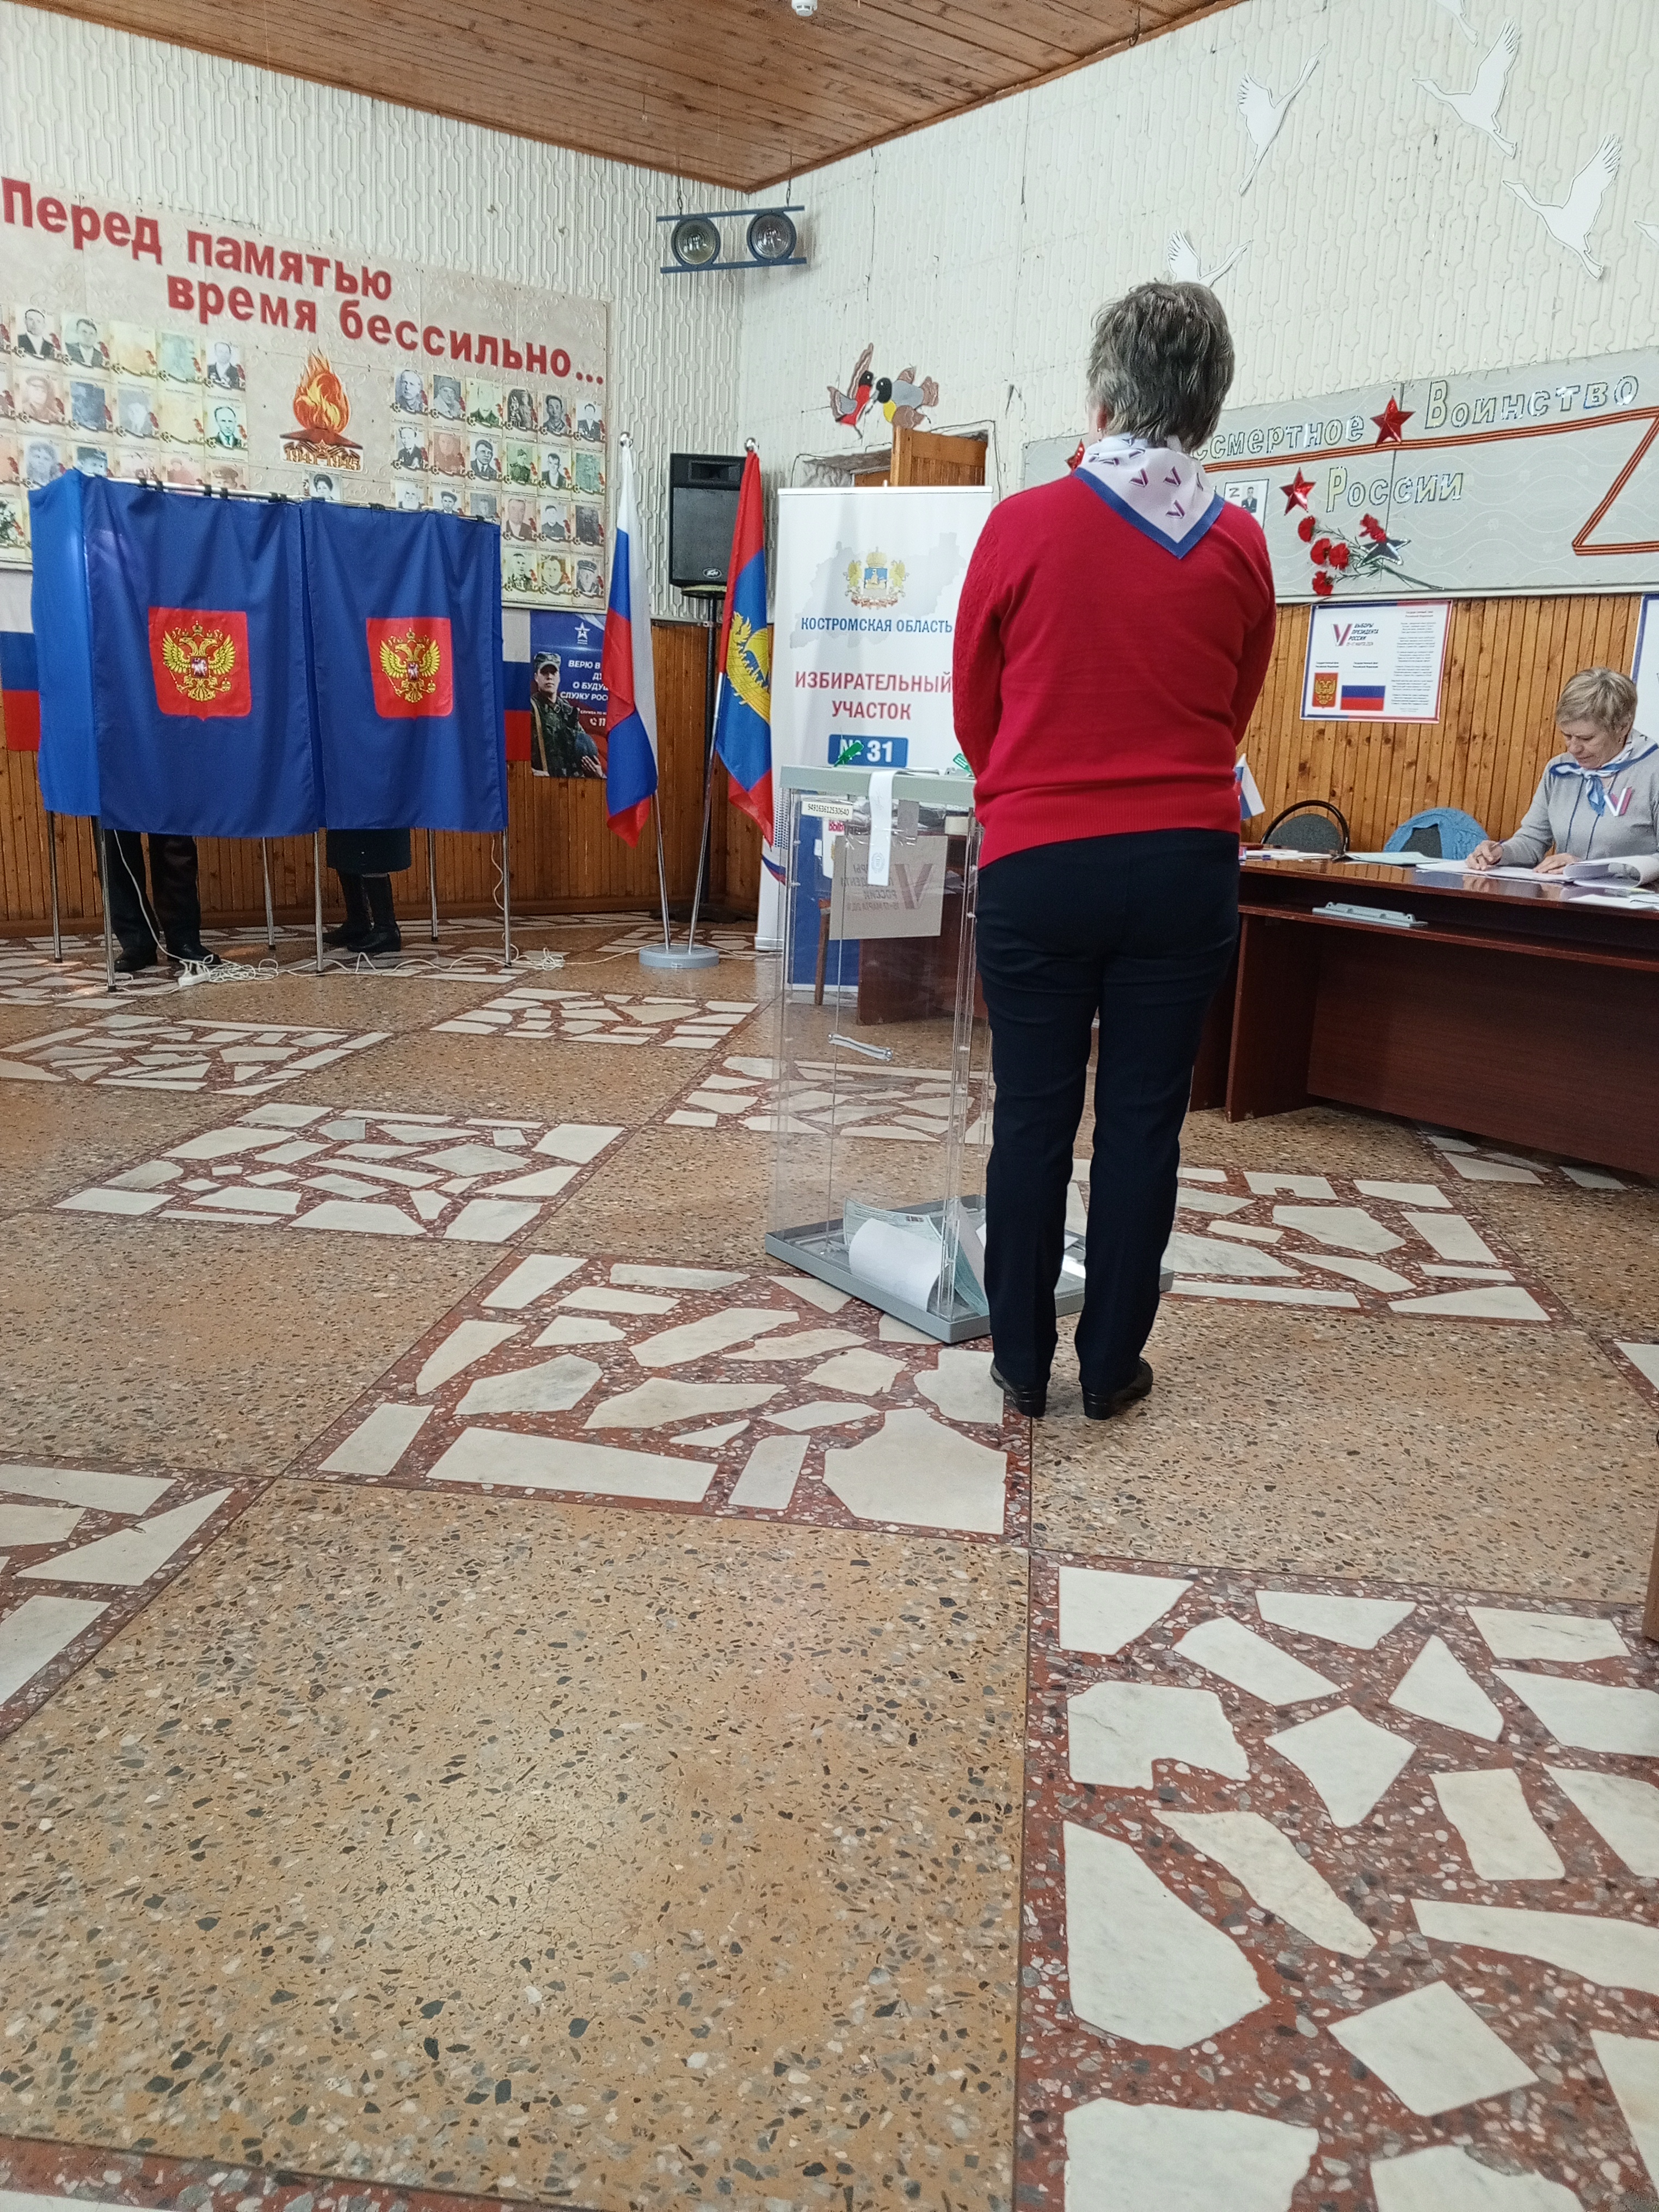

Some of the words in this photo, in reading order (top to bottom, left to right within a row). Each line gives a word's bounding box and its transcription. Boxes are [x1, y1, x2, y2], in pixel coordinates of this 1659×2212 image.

[2, 176, 163, 265] Перед
[187, 229, 391, 300] памятью
[167, 274, 317, 333] время
[339, 299, 604, 385] бессильно...
[1424, 375, 1639, 429] Воинство
[1326, 466, 1464, 513] России
[801, 618, 892, 632] КОСТРОМСКАЯ
[896, 620, 952, 633] ОБЛАСТЬ
[568, 660, 593, 668] ВЕРЮ
[795, 672, 951, 693] ИЗБИРАТЕЛЬНЫЙ
[560, 691, 590, 700] СЛУЖУ
[832, 701, 911, 720] УЧАСТОК
[867, 740, 893, 763] 31
